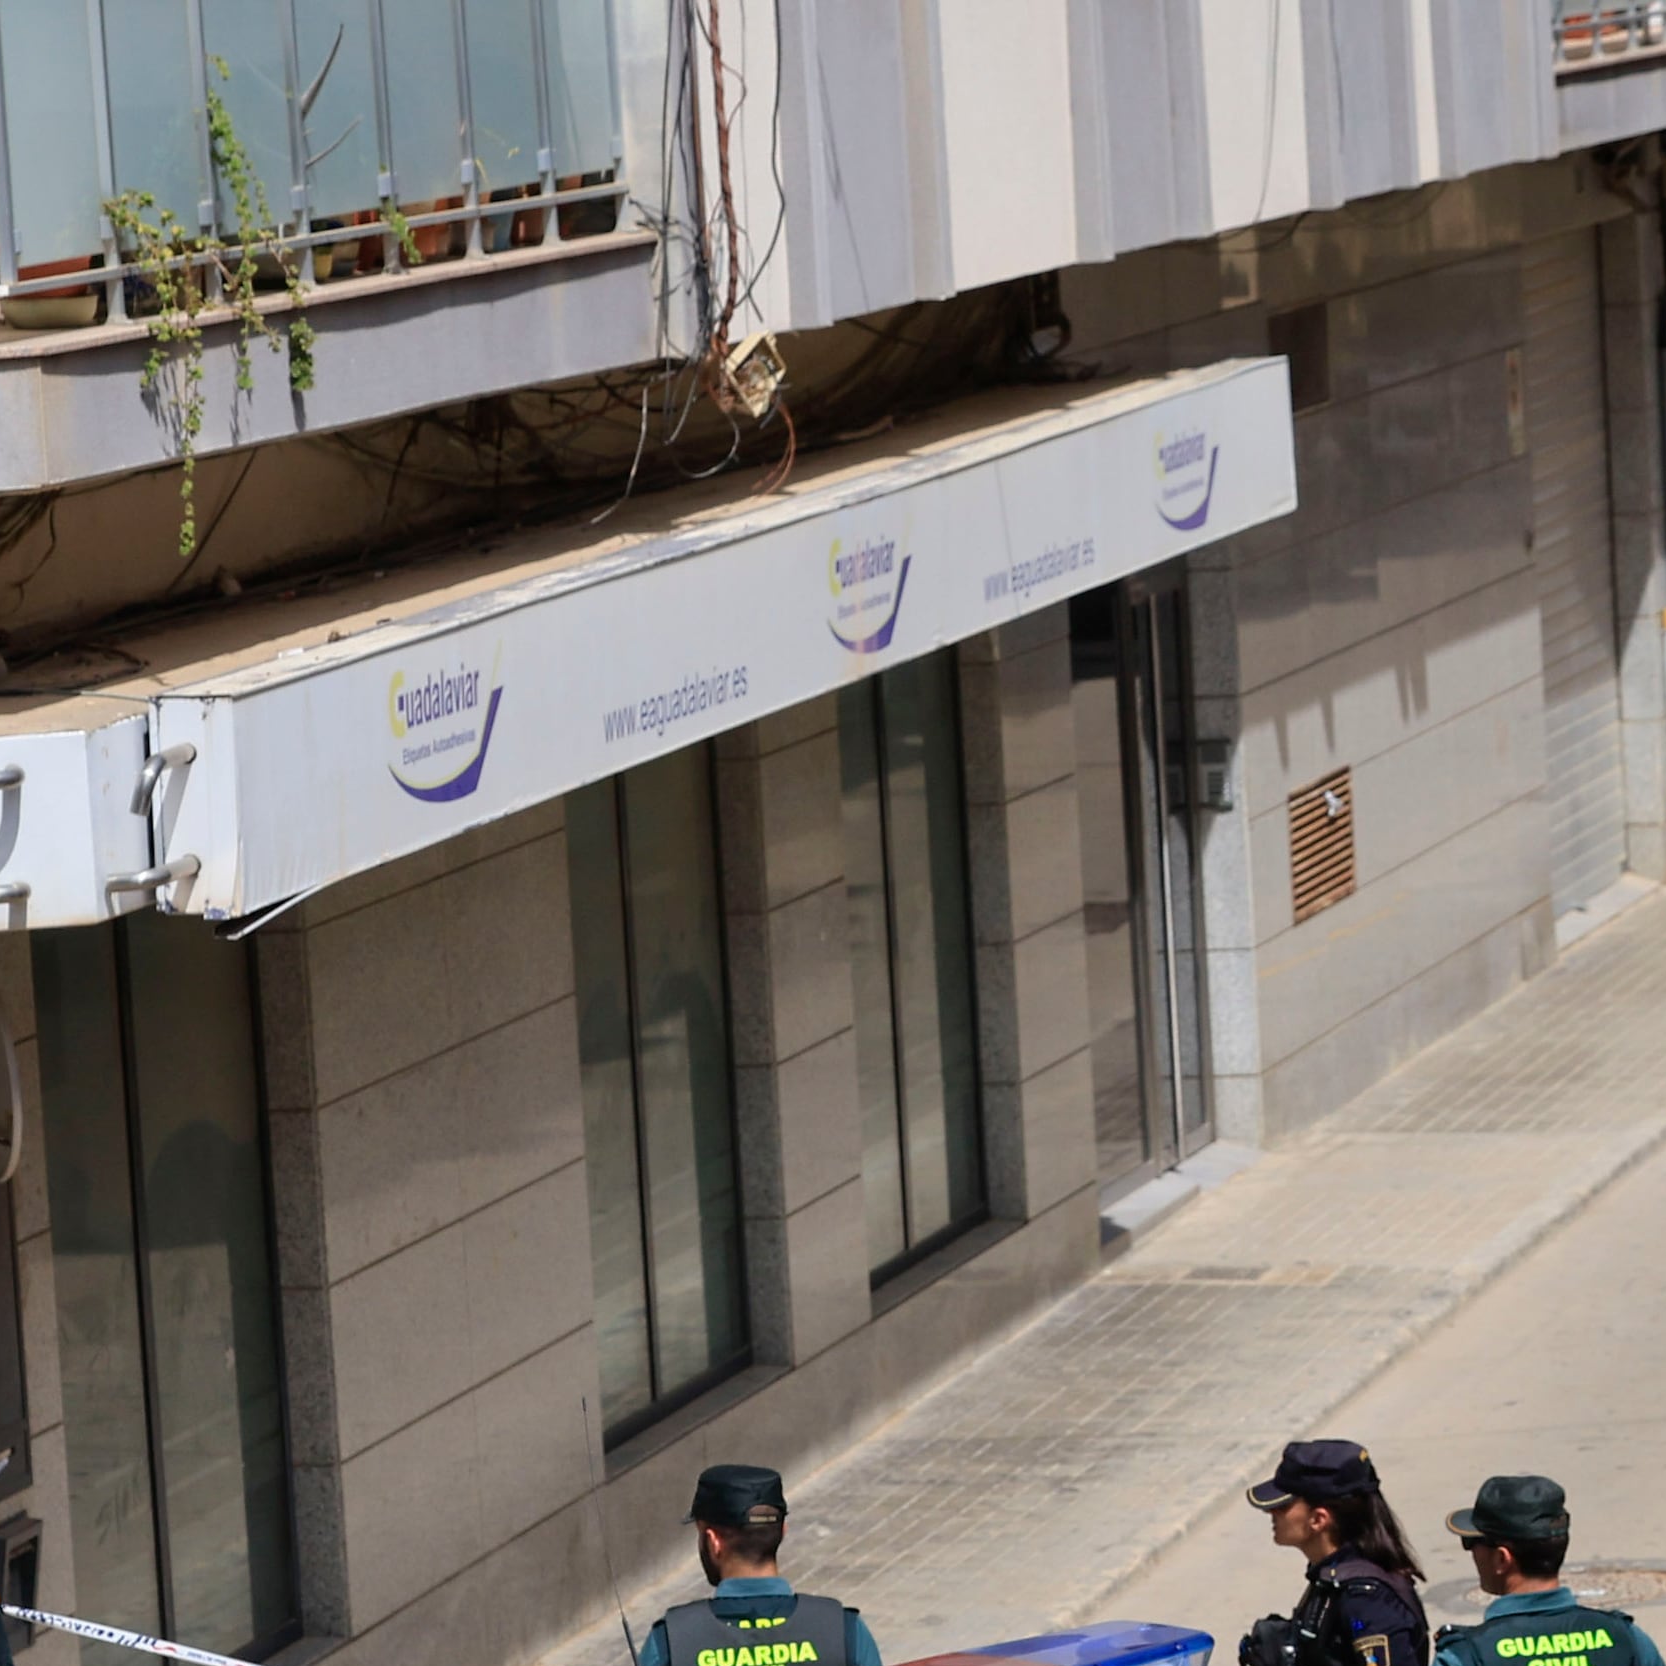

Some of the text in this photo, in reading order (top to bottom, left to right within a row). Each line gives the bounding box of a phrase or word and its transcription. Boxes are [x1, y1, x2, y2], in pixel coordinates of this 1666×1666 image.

[388, 662, 480, 738] Guadalaviar
[603, 666, 748, 743] www.eaguadalaviar.es
[1496, 1628, 1613, 1657] GUARDIA
